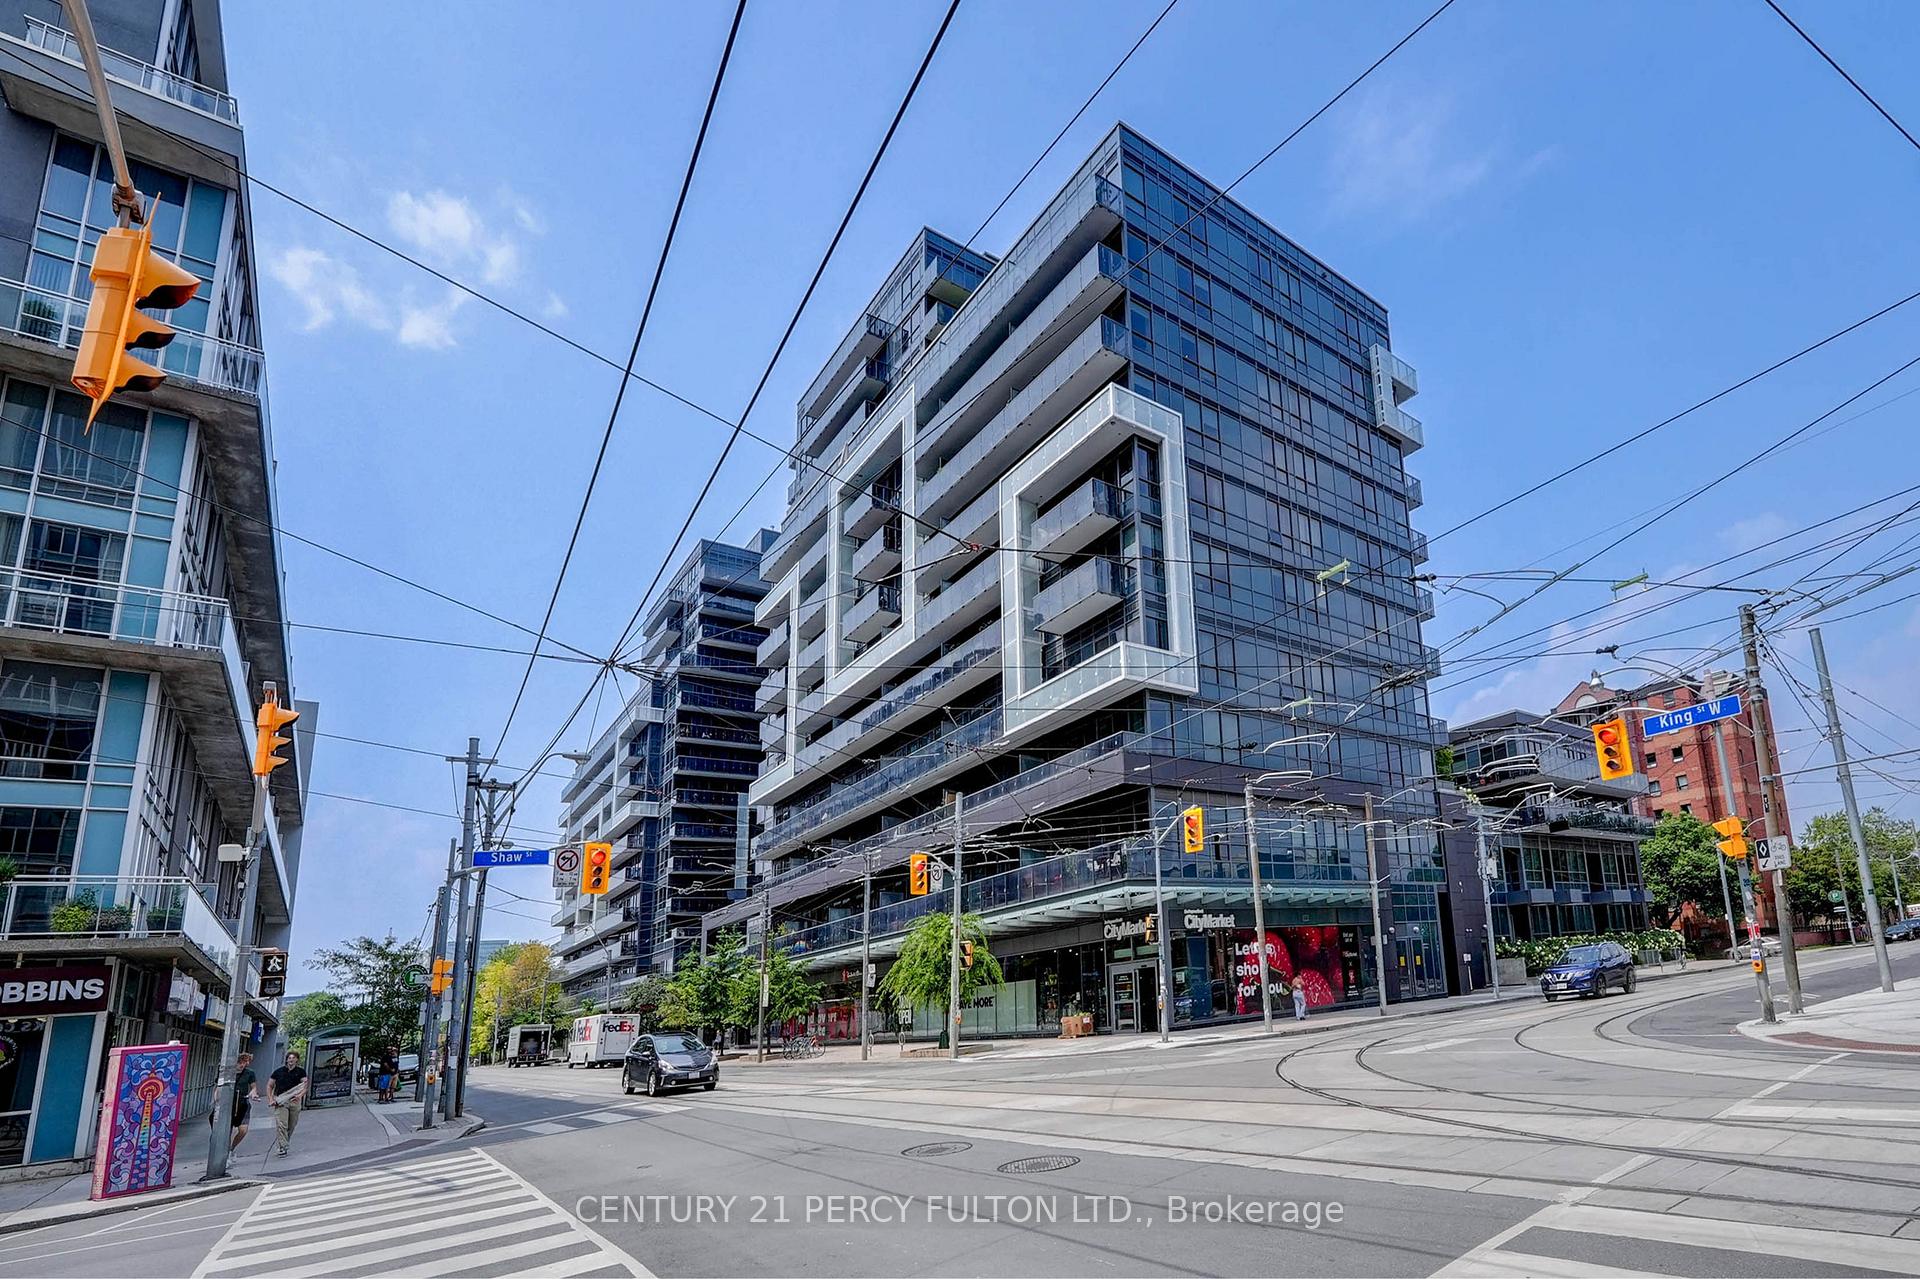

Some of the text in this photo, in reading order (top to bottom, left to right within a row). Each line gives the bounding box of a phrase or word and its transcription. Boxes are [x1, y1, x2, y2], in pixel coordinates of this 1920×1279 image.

[1659, 701, 1721, 728] King St W
[491, 852, 523, 863] Shaw
[1236, 962, 1260, 977] sho
[0, 978, 105, 1004] BBINS
[1238, 983, 1283, 997] for ou
[973, 996, 995, 1009] MORE
[602, 1020, 635, 1033] FedEx
